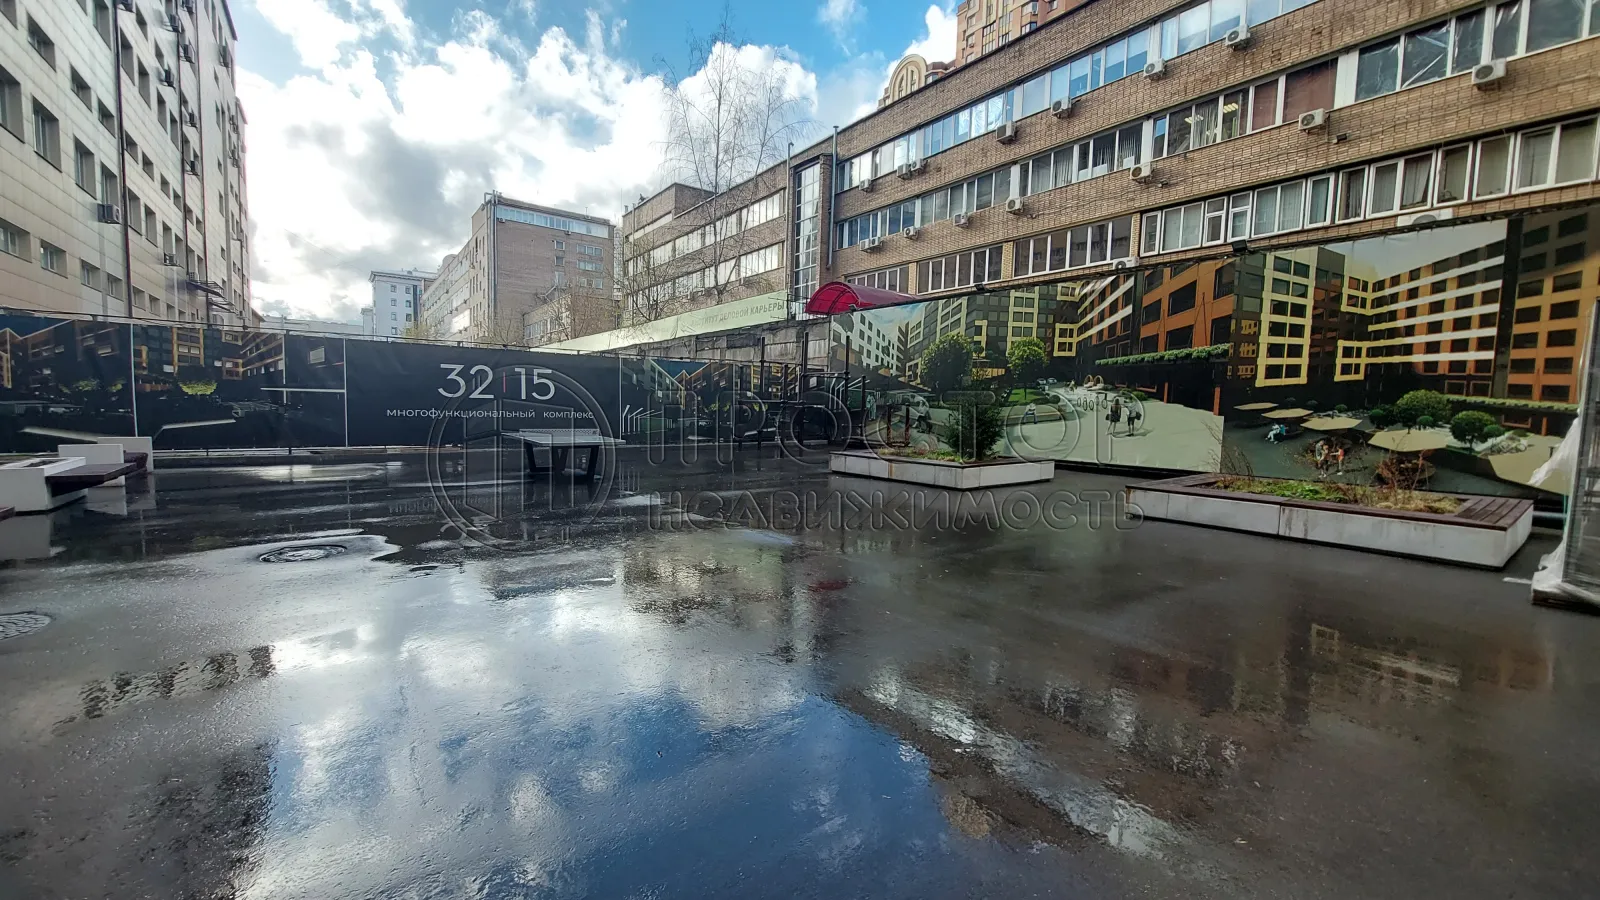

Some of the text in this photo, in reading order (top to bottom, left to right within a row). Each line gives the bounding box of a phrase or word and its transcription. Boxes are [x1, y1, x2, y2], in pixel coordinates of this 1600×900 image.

[719, 307, 749, 322] ДЕЛОВОЙ
[751, 302, 784, 315] КАРЬЕРЫ
[438, 363, 556, 400] 32 15
[386, 407, 595, 420] многофункциональный комплекс
